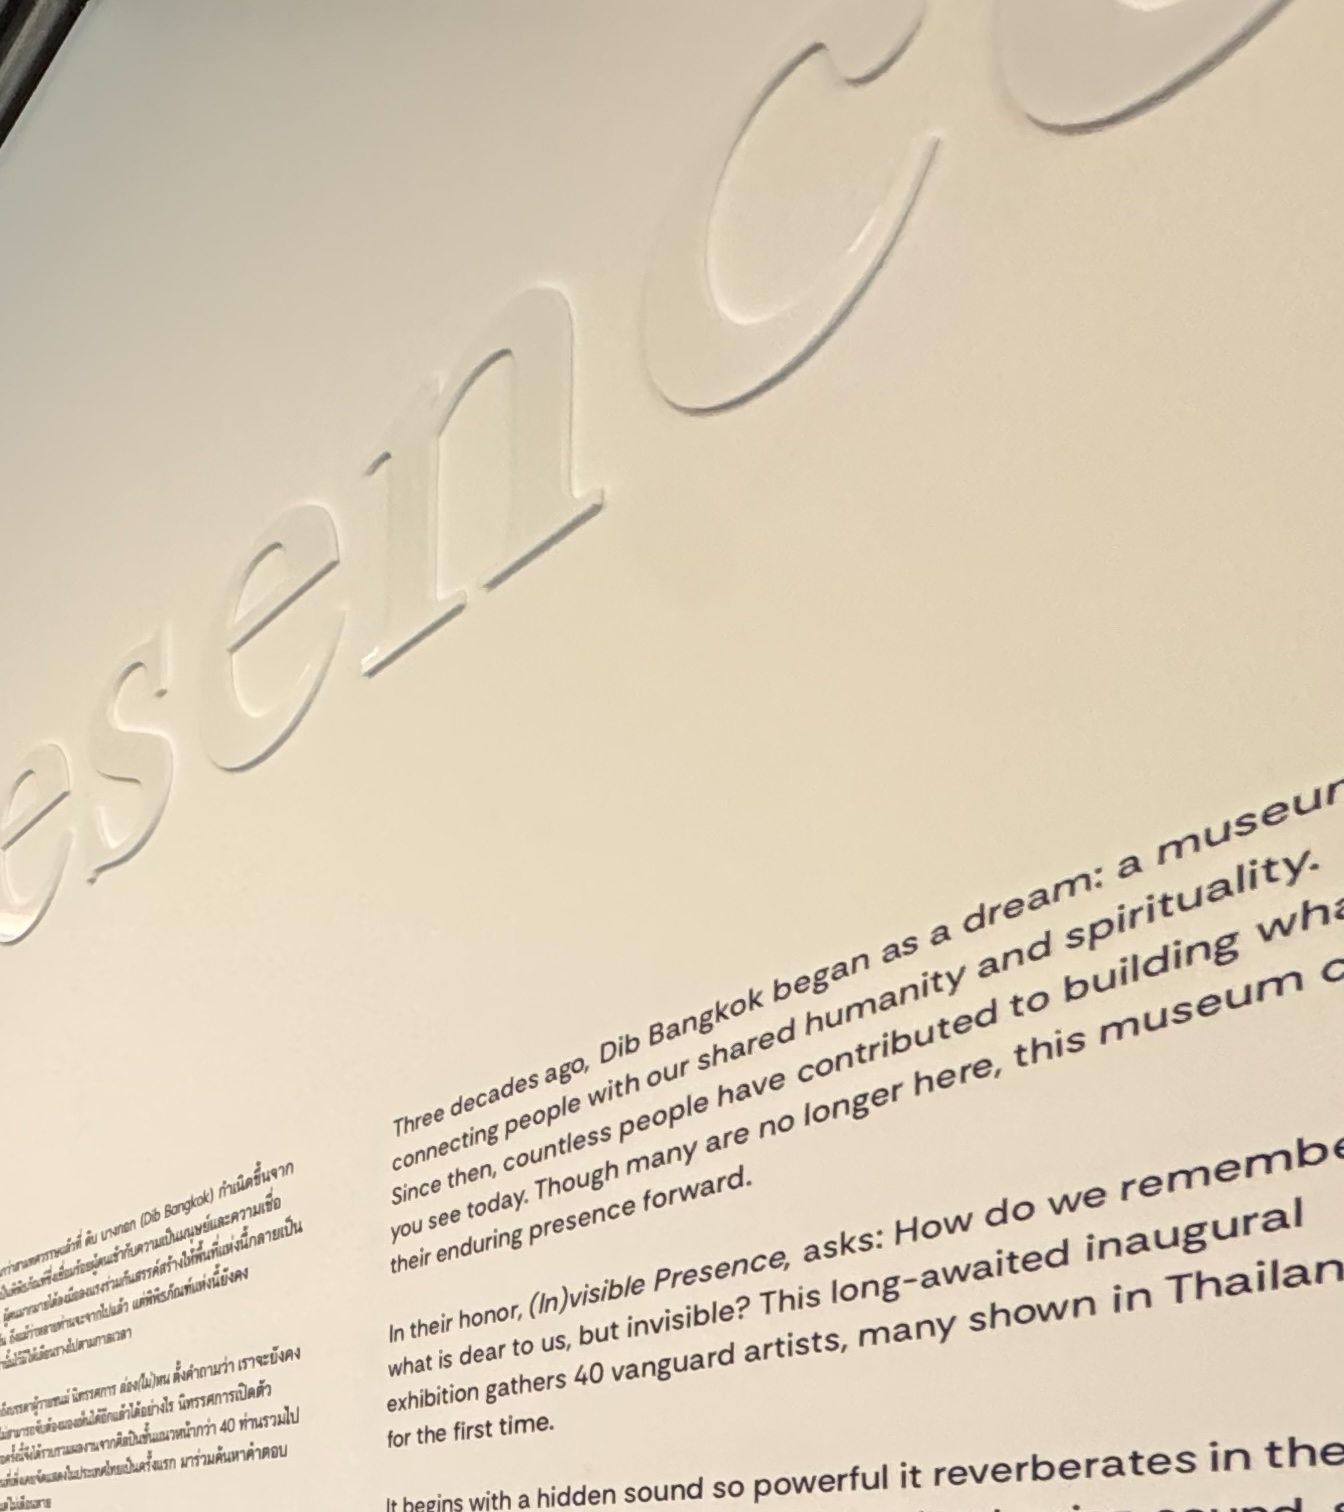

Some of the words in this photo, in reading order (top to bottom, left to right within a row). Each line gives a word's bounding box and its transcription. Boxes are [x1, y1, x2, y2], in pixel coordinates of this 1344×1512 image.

[392, 1107, 445, 1137] Three
[449, 1073, 539, 1117] decades
[544, 1057, 590, 1086] ago,
[600, 1033, 641, 1065] Dib
[648, 987, 765, 1047] Bangkok
[773, 952, 870, 1003] began
[881, 935, 919, 964] as
[929, 924, 953, 947] a
[962, 866, 1103, 934] dream:
[1117, 855, 1144, 880] a
[392, 1123, 499, 1172] connecting
[504, 1095, 582, 1141] people
[587, 1073, 641, 1107] with
[646, 1058, 690, 1088] our
[697, 1016, 796, 1071] shared
[805, 964, 967, 1036] humanity
[977, 929, 1053, 979] and
[1065, 849, 1320, 952] spirituality.
[389, 1324, 405, 1344] In
[409, 1312, 454, 1339] their
[459, 1304, 523, 1329] honor,
[529, 1275, 646, 1320] (In)visible
[653, 1250, 791, 1293] Presence,
[803, 1229, 884, 1264] asks:
[894, 1211, 974, 1246] How
[984, 1197, 1036, 1228] do
[1047, 1186, 1108, 1216] we
[390, 1247, 432, 1274] their
[436, 1227, 524, 1263] enduring
[529, 1199, 637, 1247] presence
[642, 1164, 753, 1212] forward.
[219, 1418, 236, 1433] 40
[387, 1429, 412, 1449] for
[416, 1424, 447, 1445] the
[453, 1419, 493, 1442] first
[498, 1414, 555, 1437] time.
[468, 1489, 512, 1512] with
[517, 1493, 531, 1510] a
[537, 1484, 617, 1509] hidden
[623, 1475, 704, 1504] sound
[712, 1479, 745, 1500] so
[753, 1463, 889, 1505] powerful
[900, 1461, 923, 1489] it
[933, 1450, 1198, 1487] reverberates
[1208, 1440, 1252, 1473] in
